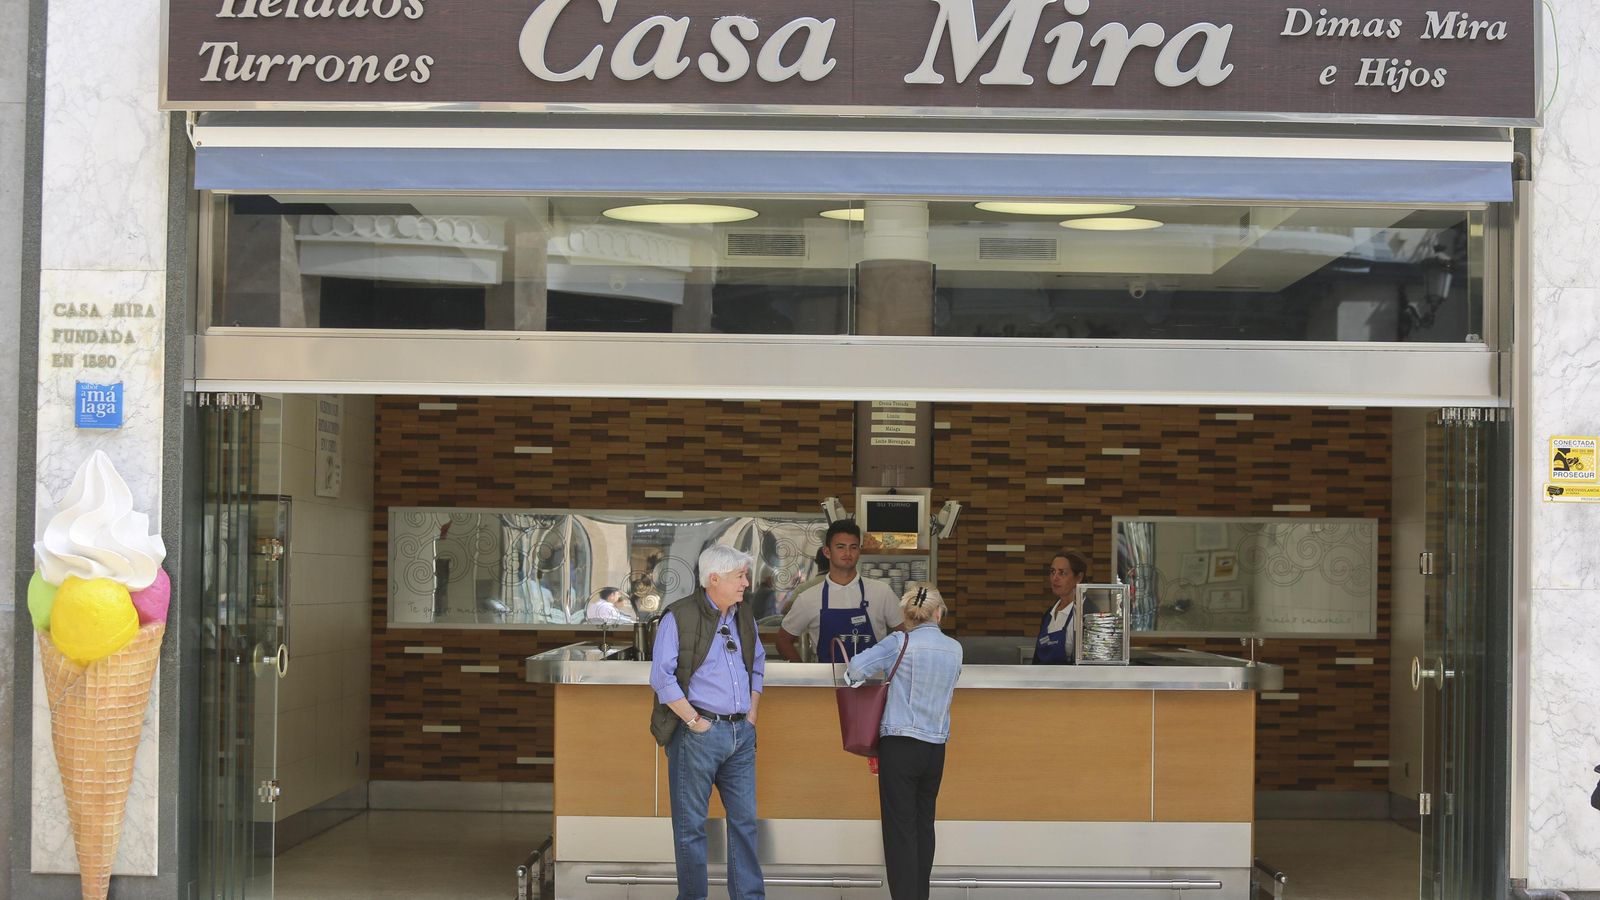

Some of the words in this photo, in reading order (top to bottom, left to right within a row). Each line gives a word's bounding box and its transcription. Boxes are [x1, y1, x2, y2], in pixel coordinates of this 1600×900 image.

[1280, 7, 1403, 39] Dimas
[1419, 10, 1508, 41] Mira
[518, 0, 837, 83] Casa
[903, 0, 1234, 87] Mira
[198, 41, 434, 84] Turrones
[1319, 65, 1337, 85] e
[1354, 57, 1448, 93] Hijos
[53, 303, 101, 317] CASA
[112, 303, 156, 318] MIRA
[51, 328, 136, 344] FUNDADA
[51, 353, 75, 368] EN
[87, 386, 117, 402] má
[81, 398, 117, 418] laga
